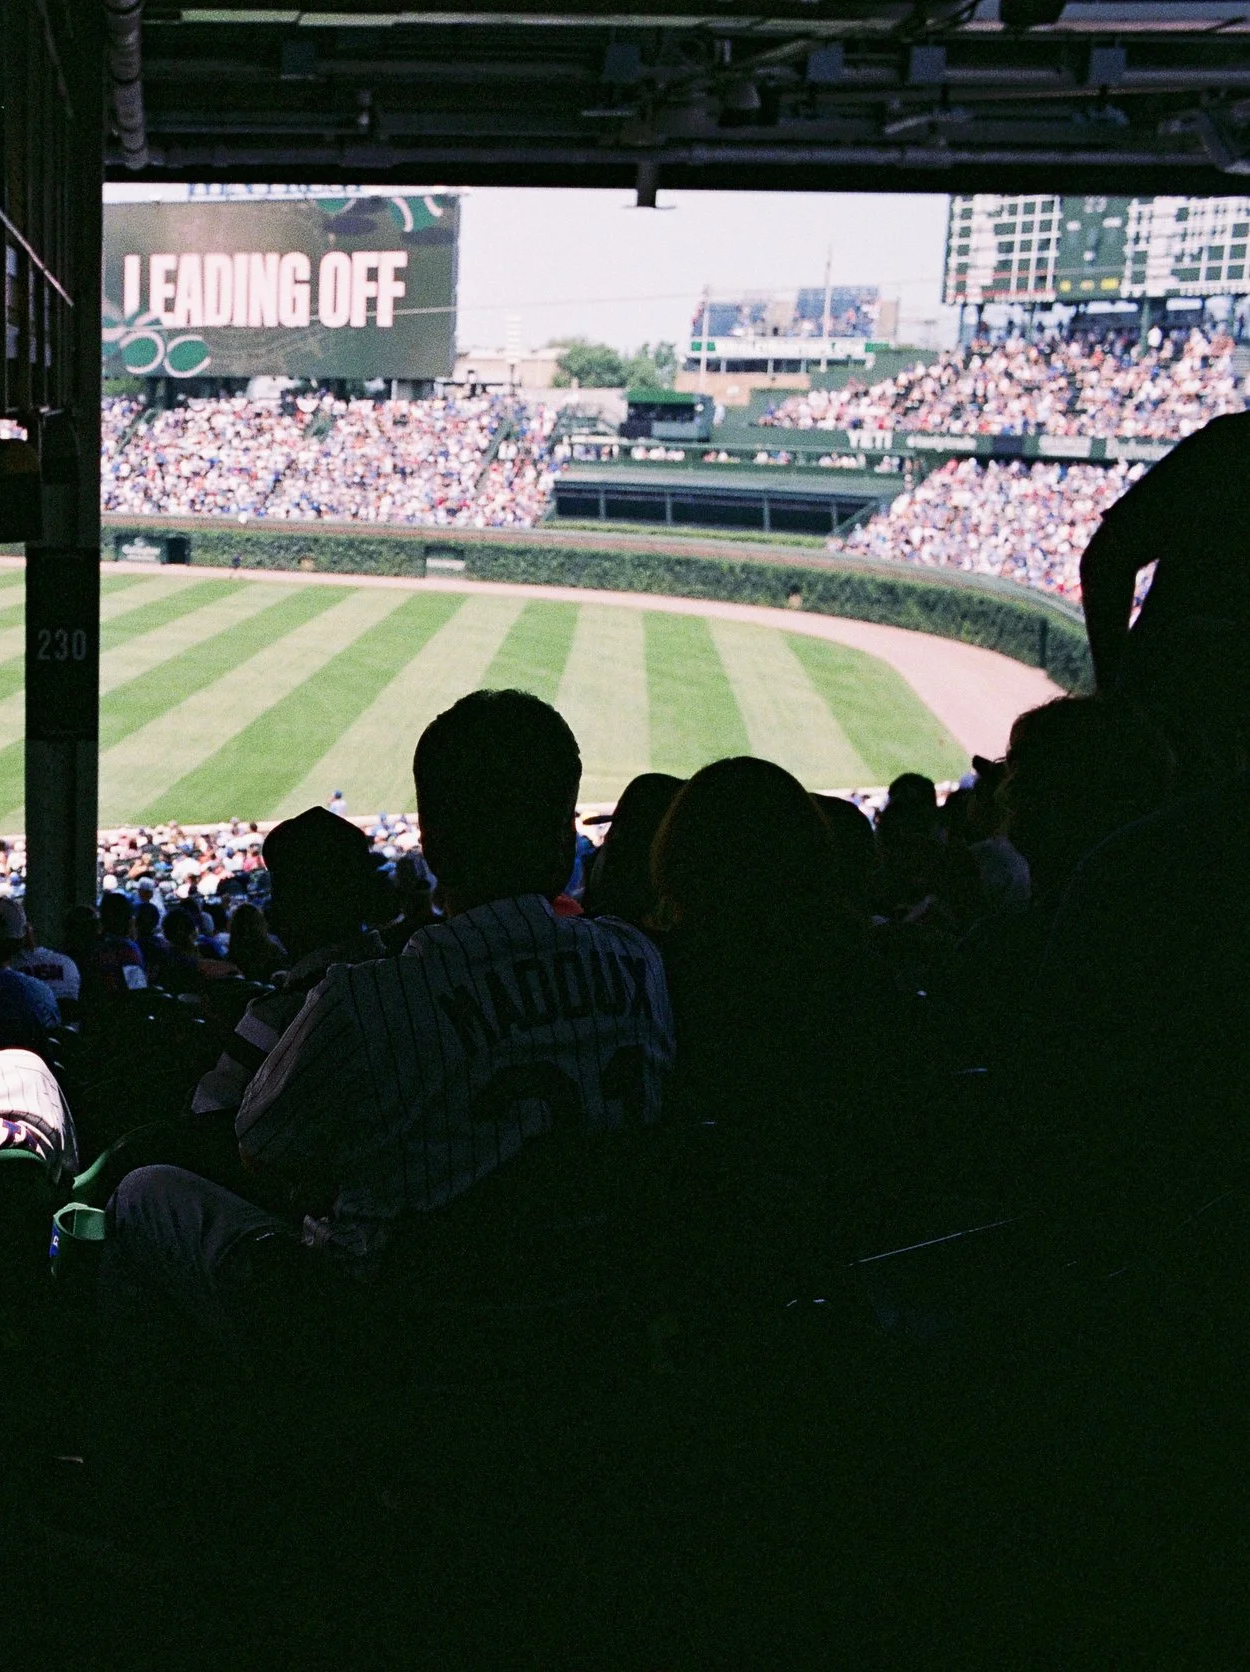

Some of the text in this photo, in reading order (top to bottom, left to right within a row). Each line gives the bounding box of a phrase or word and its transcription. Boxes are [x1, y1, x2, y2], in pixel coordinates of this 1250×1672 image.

[123, 250, 408, 328] LEADING OFF
[37, 628, 88, 661] 230
[437, 950, 655, 1055] MADDUX
